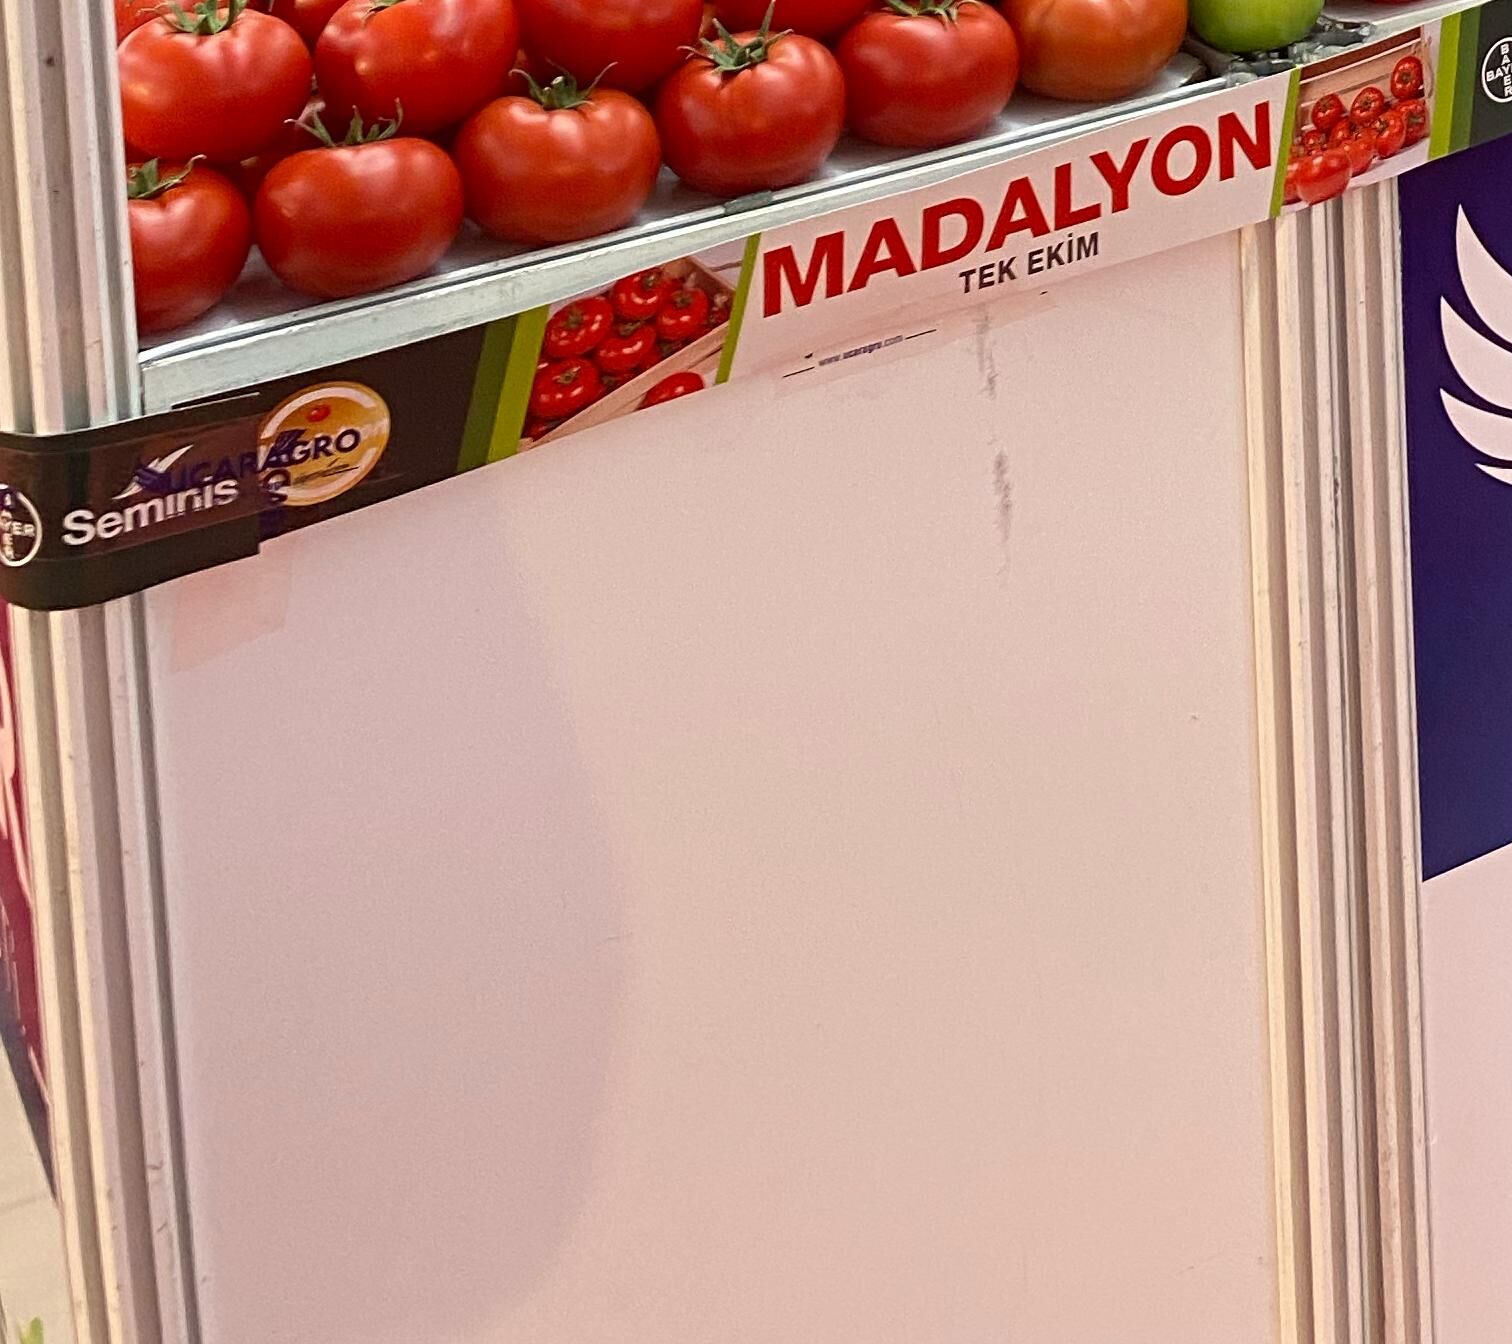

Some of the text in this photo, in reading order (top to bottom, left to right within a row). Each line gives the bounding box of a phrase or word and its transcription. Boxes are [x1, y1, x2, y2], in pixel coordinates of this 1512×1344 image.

[762, 101, 1272, 319] MADALYON
[959, 231, 1100, 295] TEK EKİM
[61, 477, 239, 547] Seminis
